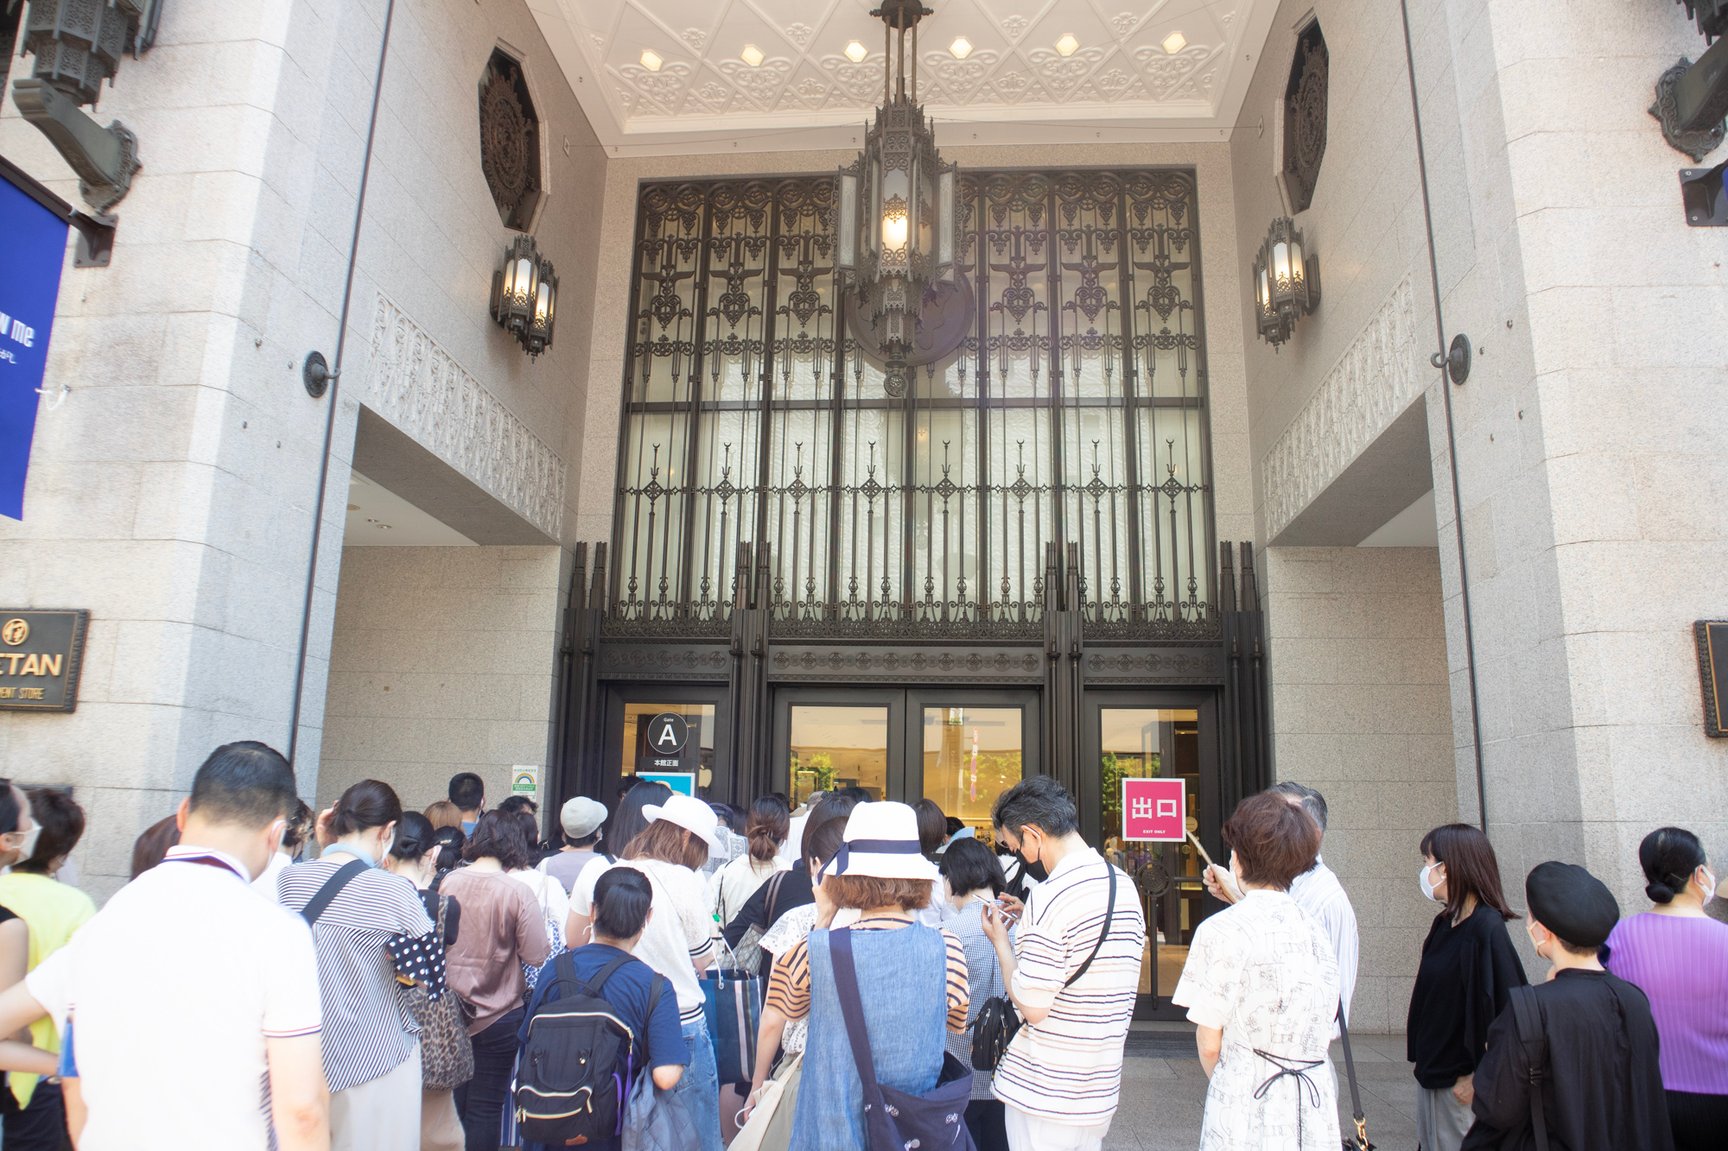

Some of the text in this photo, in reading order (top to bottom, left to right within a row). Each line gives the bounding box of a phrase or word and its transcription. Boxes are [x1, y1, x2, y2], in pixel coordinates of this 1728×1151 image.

[11, 319, 35, 348] me
[0, 653, 63, 676] TAN
[658, 724, 677, 746] A
[1132, 797, 1177, 819] 出口
